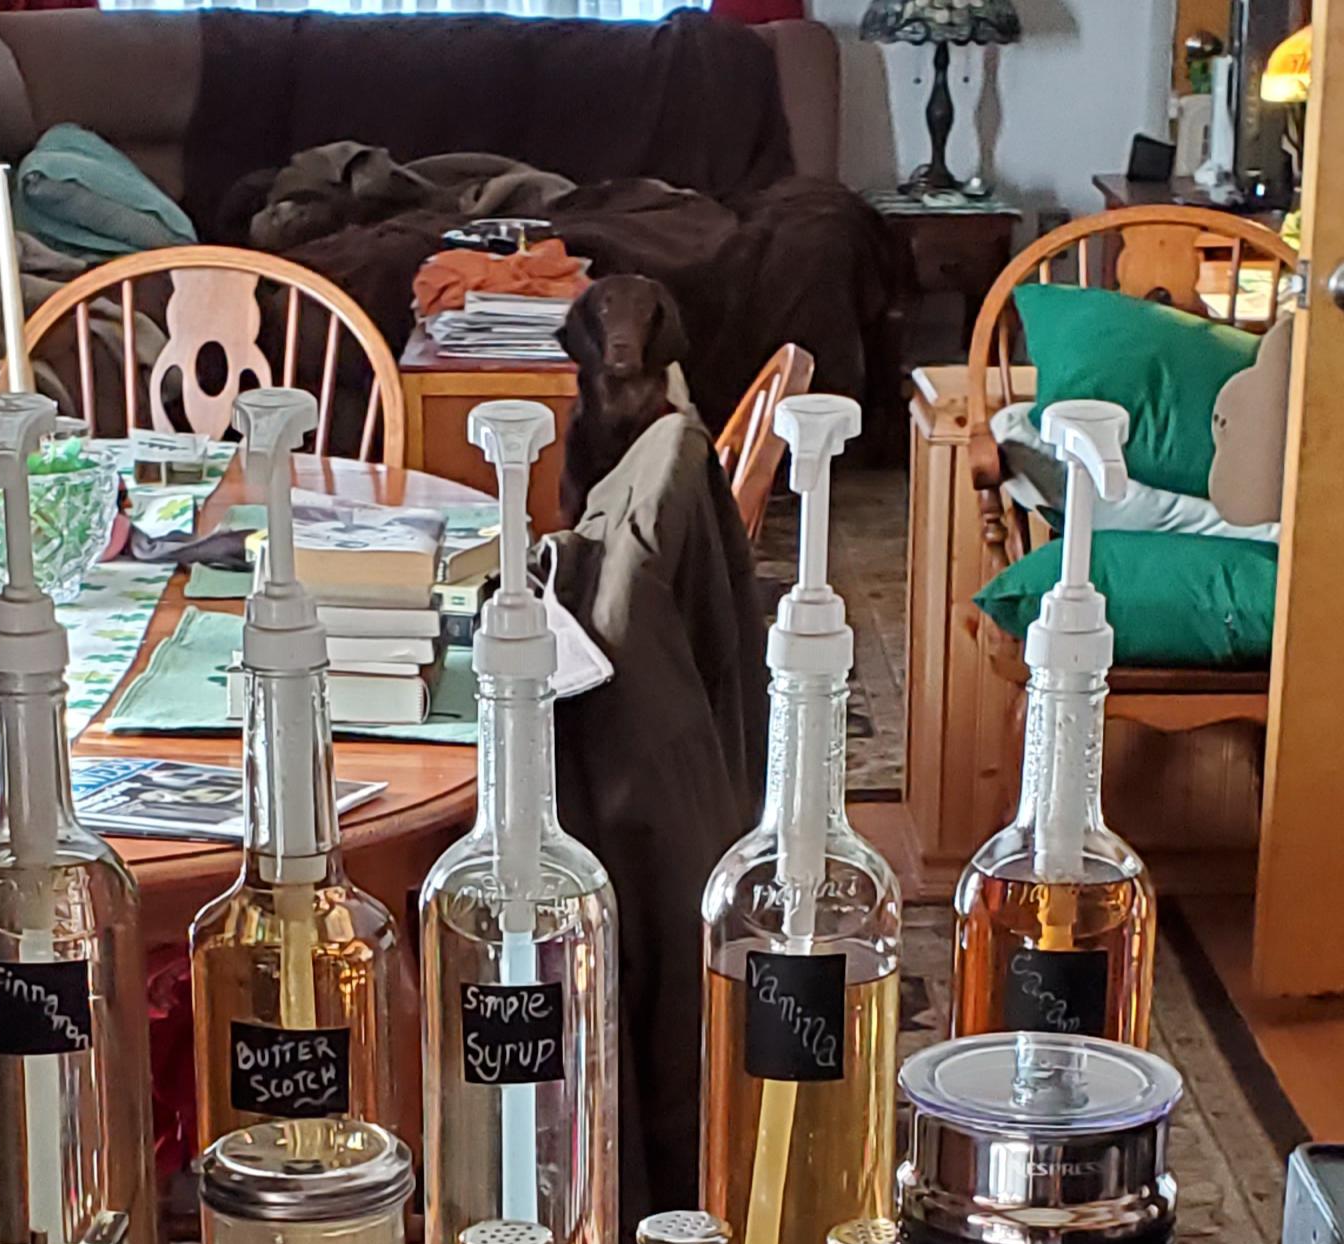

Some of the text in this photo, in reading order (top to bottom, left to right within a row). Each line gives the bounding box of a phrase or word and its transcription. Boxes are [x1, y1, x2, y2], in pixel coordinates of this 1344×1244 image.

[236, 1036, 337, 1070] BUTTER
[466, 1031, 556, 1082] Syrup
[250, 1063, 337, 1102] SCOTCH
